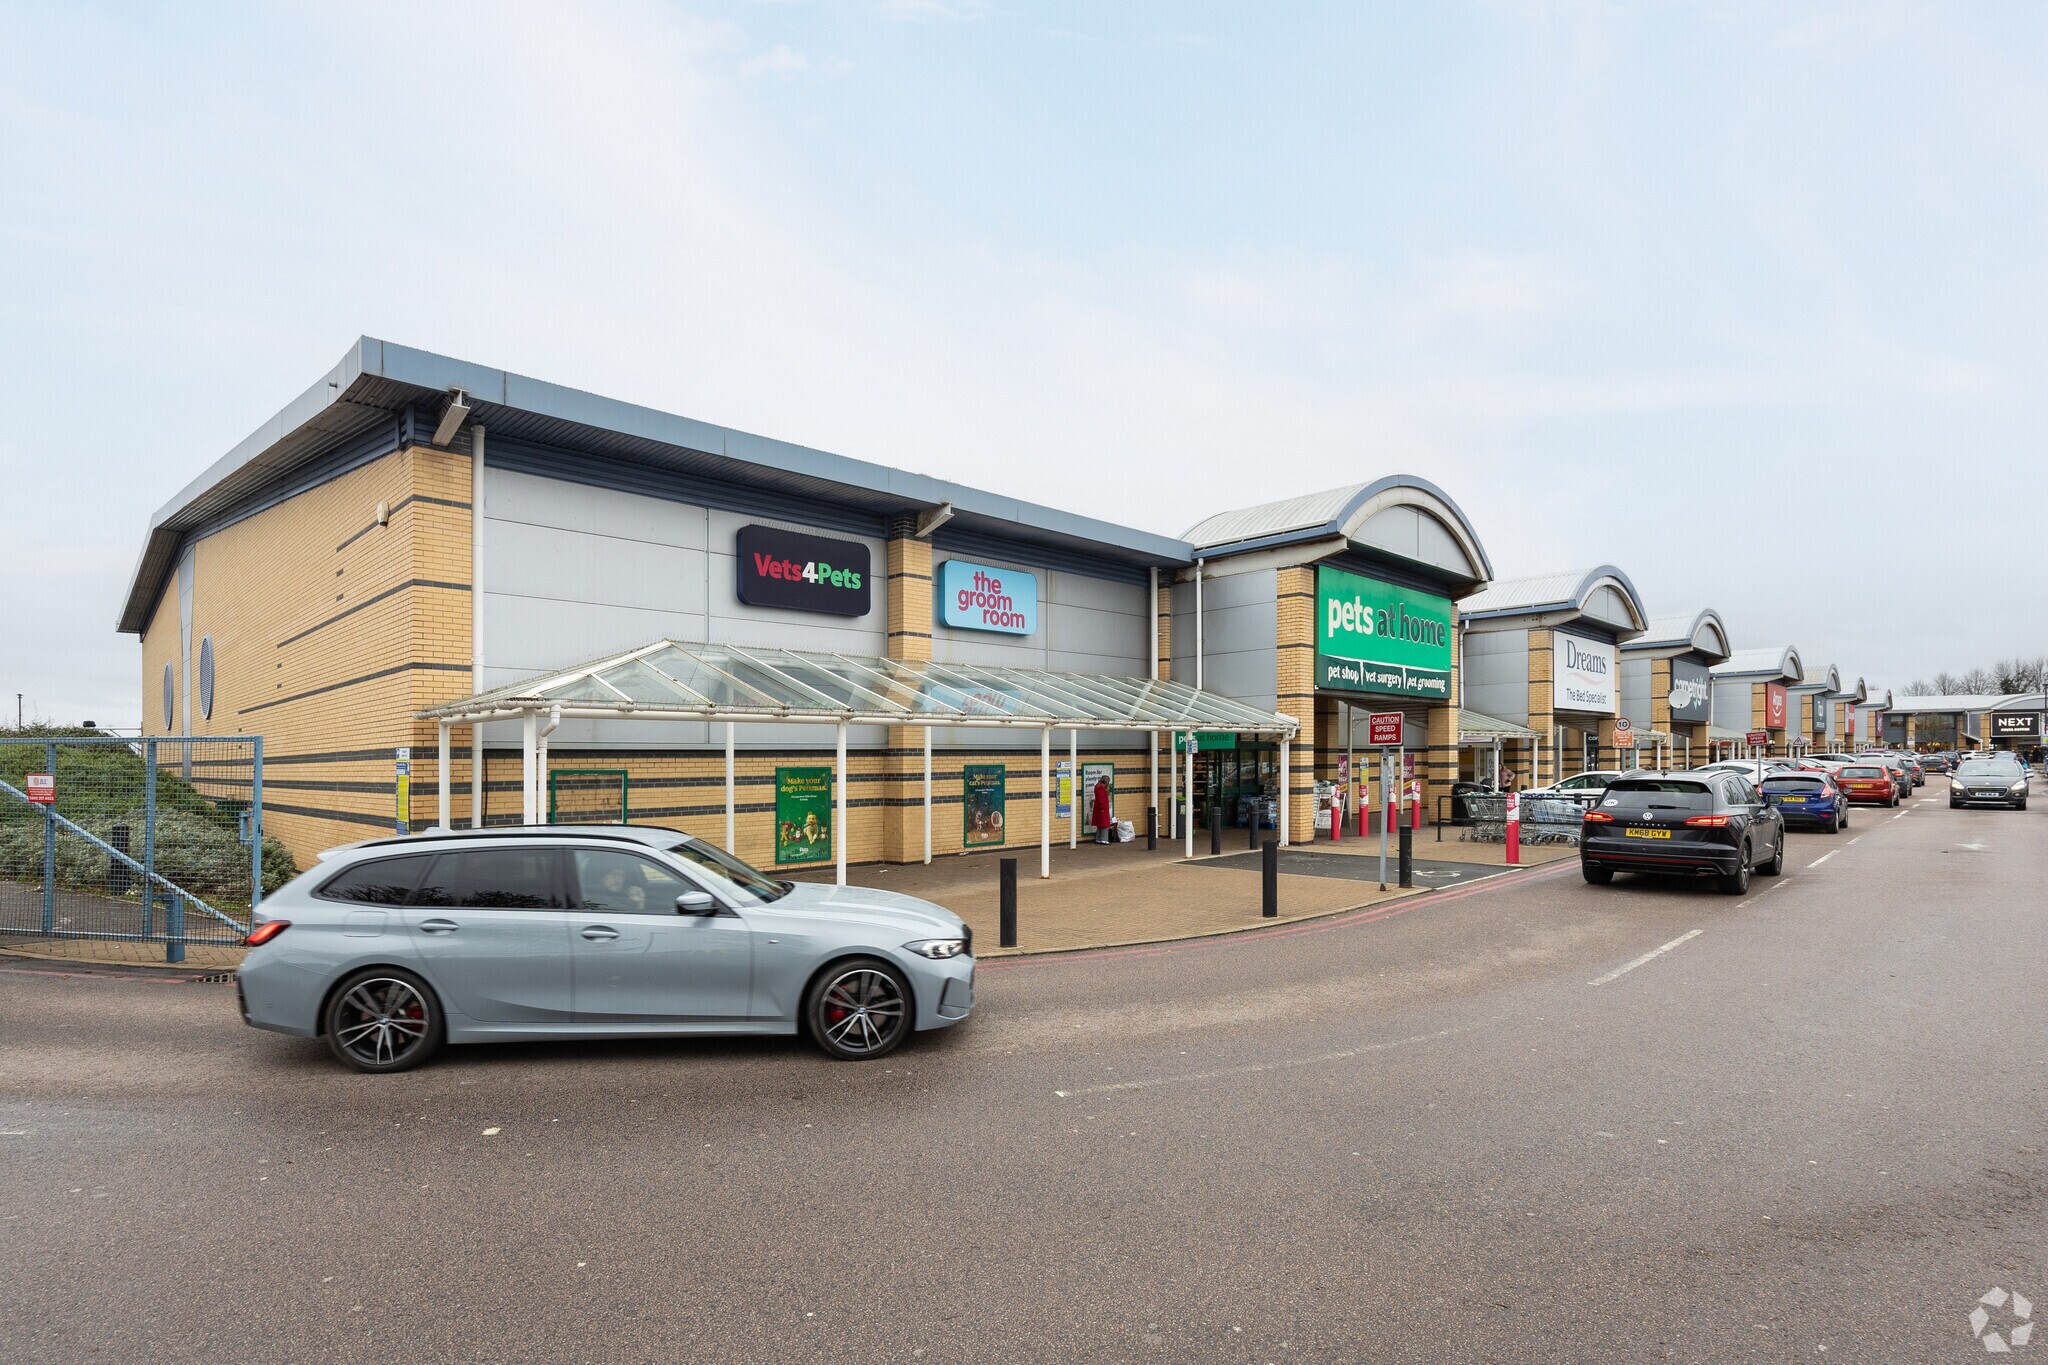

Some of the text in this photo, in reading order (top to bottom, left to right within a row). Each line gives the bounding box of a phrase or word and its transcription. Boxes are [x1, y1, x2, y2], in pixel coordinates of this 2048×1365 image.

[754, 552, 861, 590] Vets4Pets
[973, 570, 1002, 593] the
[957, 589, 1012, 611] groom
[982, 608, 1025, 629] room
[1328, 595, 1446, 648] pets at home
[1566, 639, 1607, 675] Dreams
[1328, 665, 1446, 693] pet shop vet surgery pet grooming
[1566, 688, 1607, 706] The Bed Specialist
[1371, 716, 1400, 725] CAUTION
[1374, 725, 1396, 733] SPEED
[1998, 718, 2033, 726] NEXT
[1197, 732, 1207, 742] at
[1207, 732, 1230, 742] home
[1374, 733, 1397, 742] RAMPS
[780, 785, 798, 794] dog's
[787, 777, 822, 785] Make your
